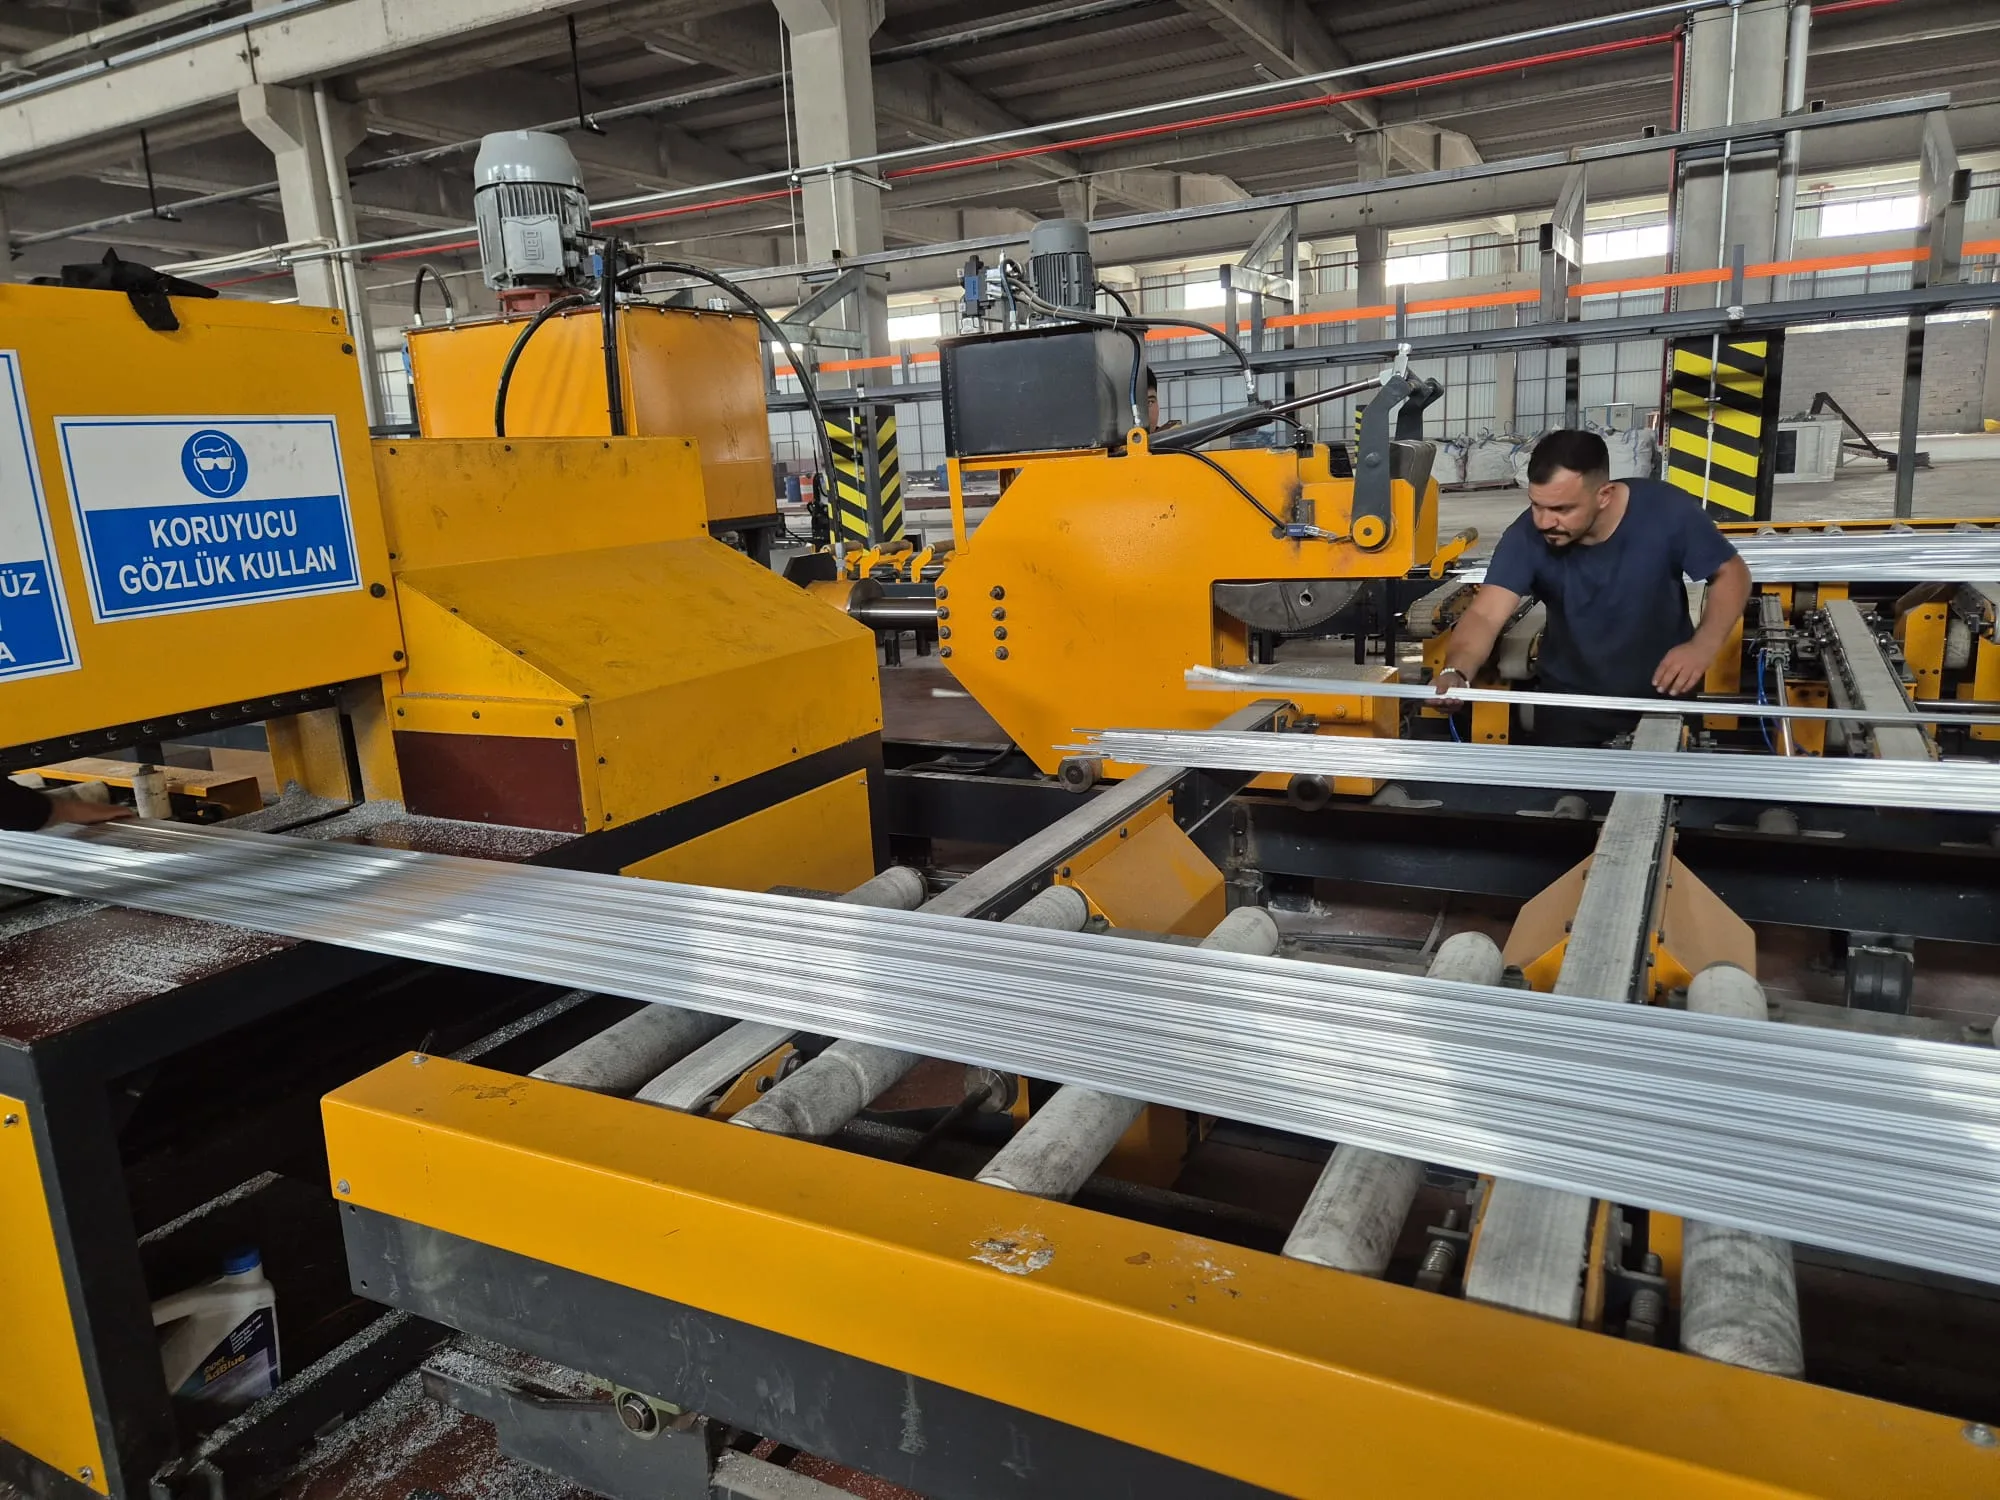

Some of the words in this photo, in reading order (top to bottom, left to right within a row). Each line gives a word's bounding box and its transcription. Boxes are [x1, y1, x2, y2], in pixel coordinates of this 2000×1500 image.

[149, 509, 297, 549] KORUYUCU
[118, 551, 236, 595] GÖZLÜK
[241, 544, 337, 581] KULLAN
